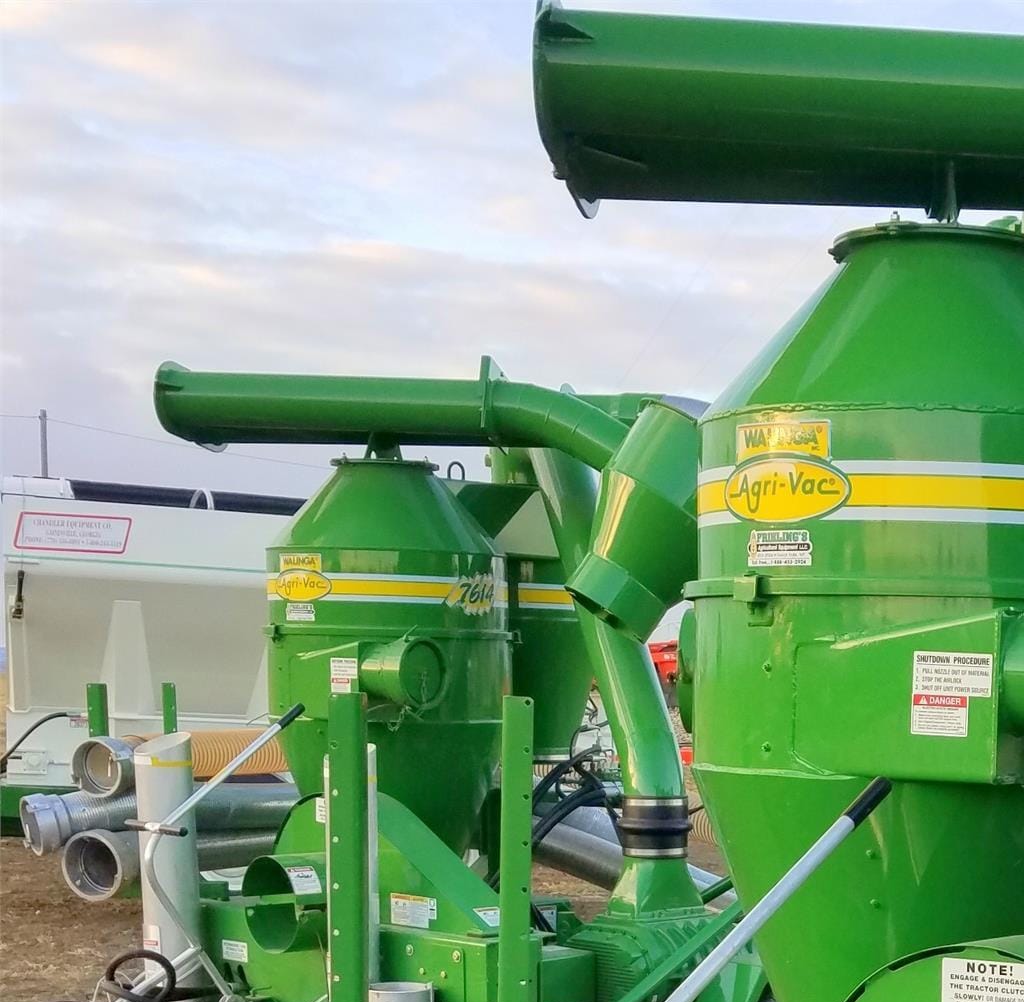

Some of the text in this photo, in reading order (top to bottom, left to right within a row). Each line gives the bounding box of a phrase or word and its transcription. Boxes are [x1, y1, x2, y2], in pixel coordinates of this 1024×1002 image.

[743, 427, 819, 449] WAGA
[729, 472, 840, 514] Agri-Vac
[278, 576, 327, 596] Agri-Vac
[916, 655, 990, 666] SHUTDOWN PROCEDURE
[929, 696, 961, 705] DANGER
[966, 962, 1013, 976] NOTE!
[950, 973, 979, 982] ENGAGE
[966, 984, 999, 993] TRACTOR
